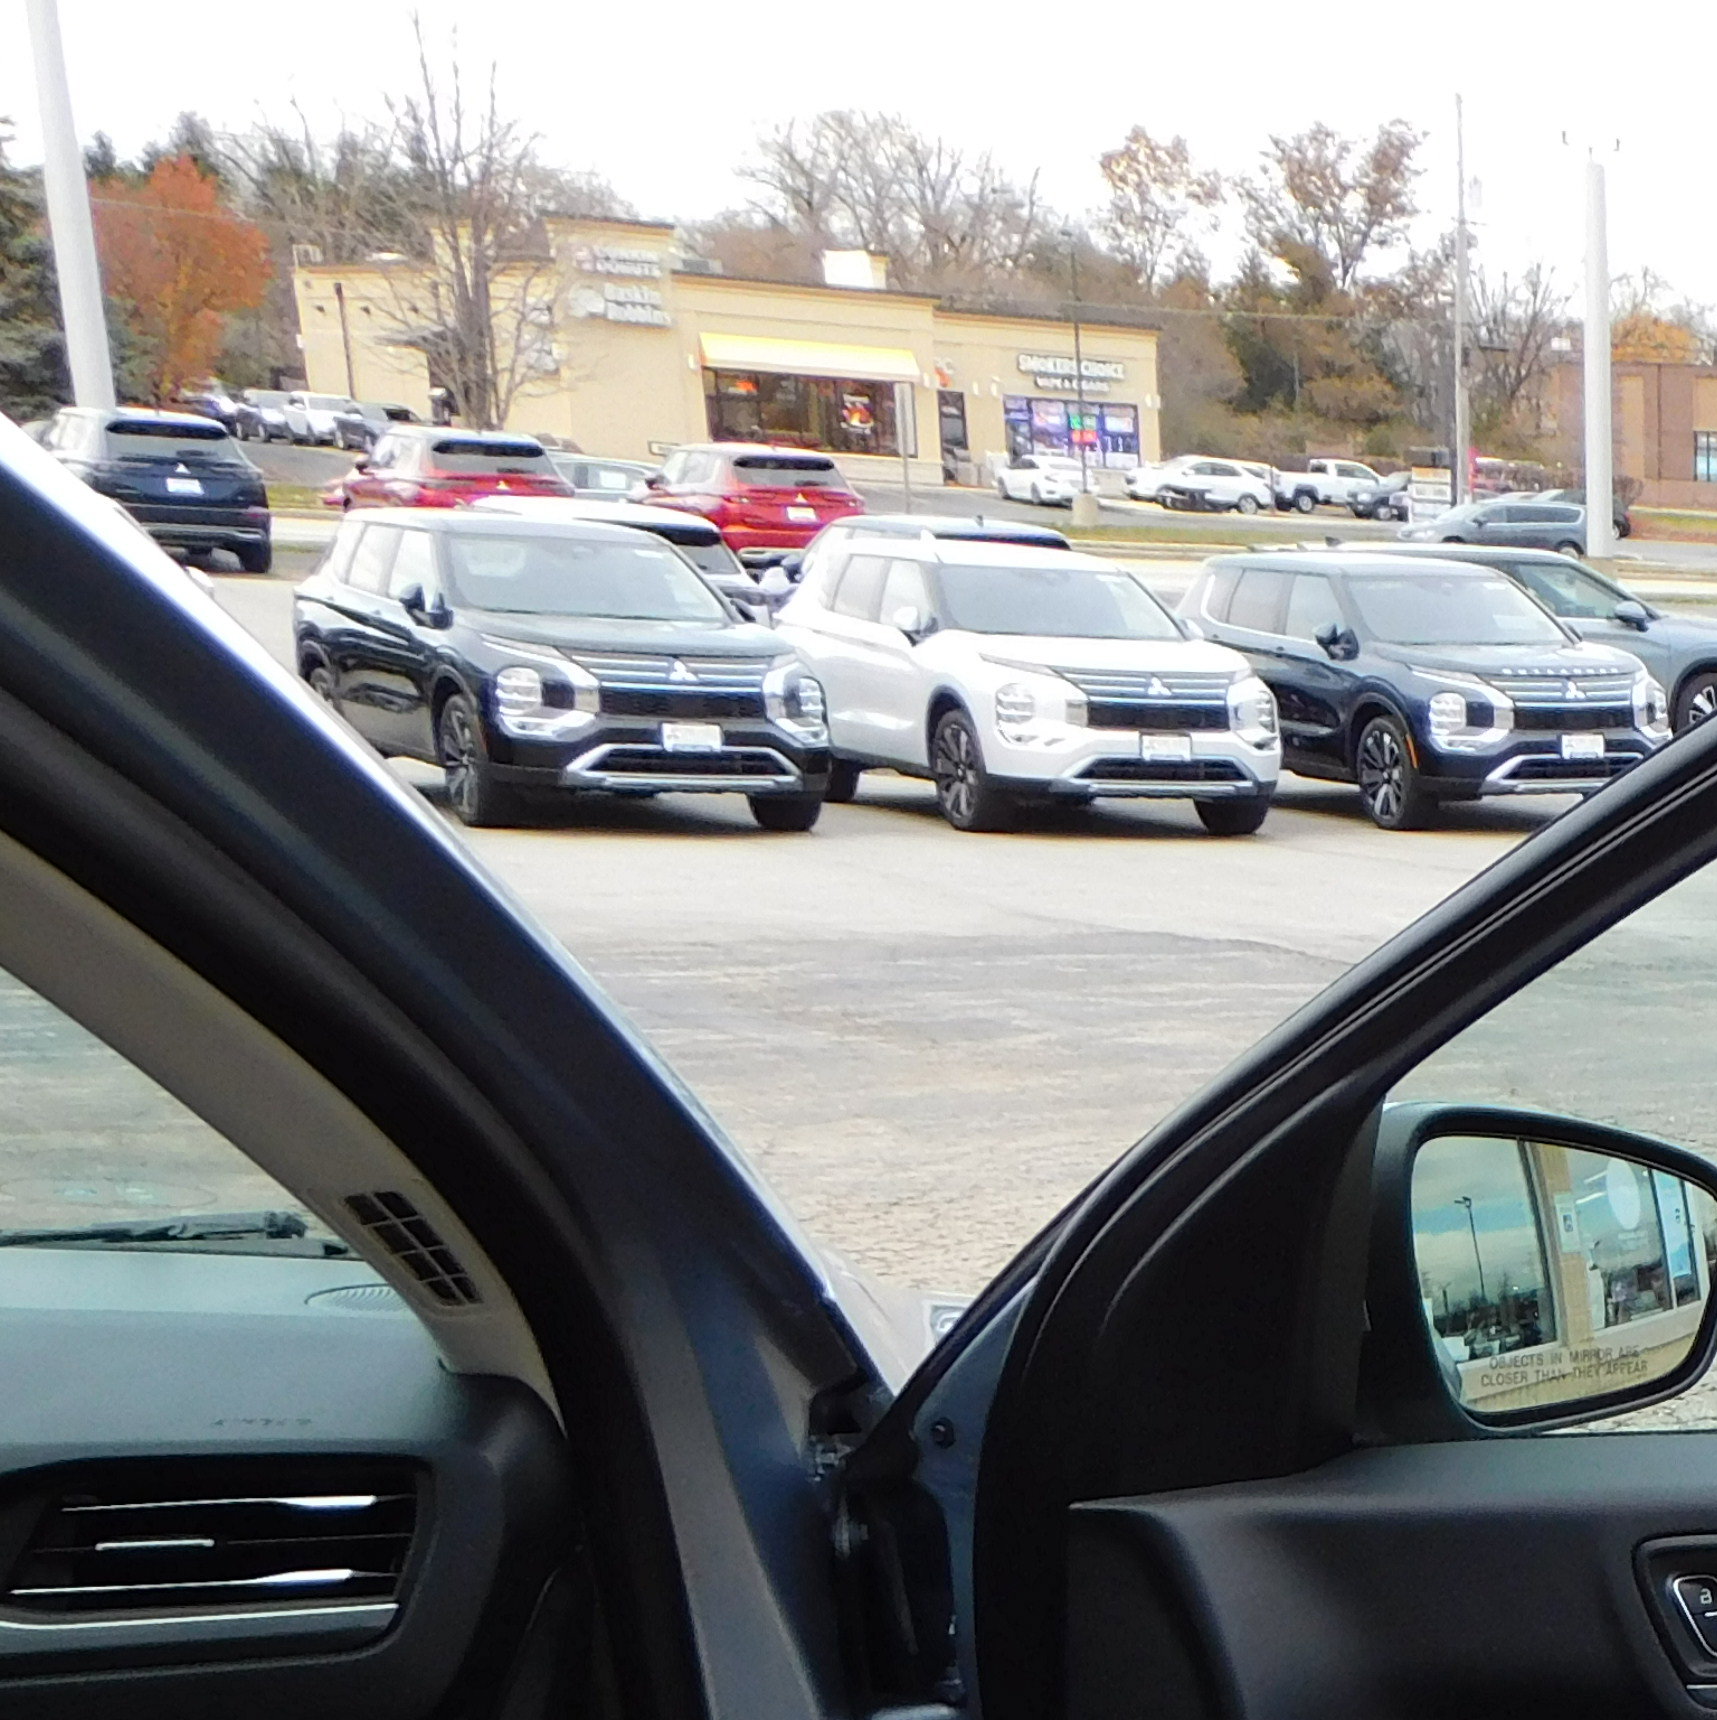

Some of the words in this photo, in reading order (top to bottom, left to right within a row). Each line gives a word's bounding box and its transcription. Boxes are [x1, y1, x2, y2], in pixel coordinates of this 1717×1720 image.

[1489, 1353, 1544, 1370] OBJECTS
[1551, 1352, 1562, 1365] IN
[1569, 1347, 1614, 1364] MIRROR
[1481, 1371, 1528, 1387] CLOSER
[1572, 1364, 1600, 1379] THEY
[1606, 1360, 1648, 1375] APPEAR
